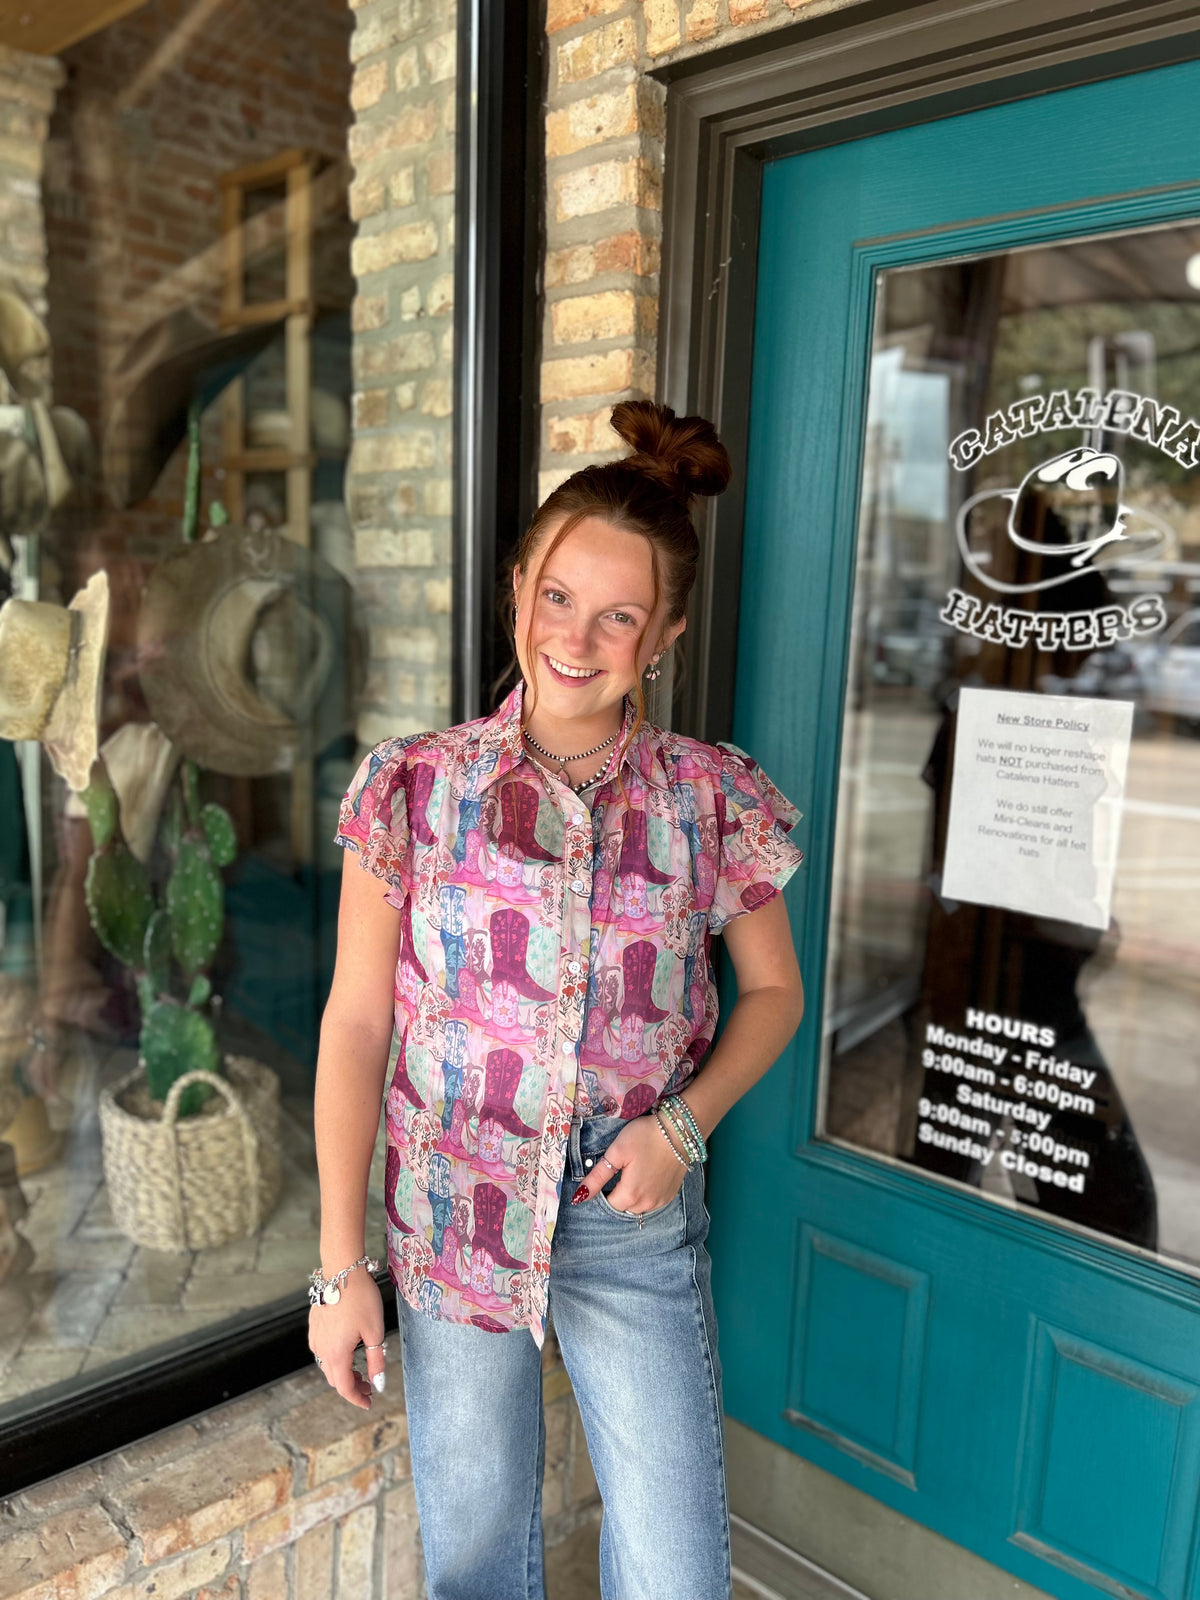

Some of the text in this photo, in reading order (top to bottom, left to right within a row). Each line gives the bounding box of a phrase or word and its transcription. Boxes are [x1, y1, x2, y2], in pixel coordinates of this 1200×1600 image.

[949, 388, 1200, 470] CATALENA
[940, 589, 1167, 650] HATTERS
[997, 713, 1089, 732] New Store Policy
[976, 753, 1105, 777] hats NOT purchased from
[978, 738, 1106, 762] We will no longer reshape
[996, 769, 1080, 789] Catalena Hatters
[994, 813, 1073, 834] Mini-Cleans and
[997, 799, 1073, 819] We do still offer
[978, 825, 1087, 851] Renovations for all felt
[1018, 846, 1040, 858] hats
[966, 1007, 1056, 1048] HOURS
[926, 1024, 1008, 1065] Monday
[1025, 1050, 1097, 1089] Friday
[922, 1049, 996, 1086] 9:00am
[1013, 1074, 1096, 1114] 6:00pm
[957, 1083, 1052, 1131] Saturday
[918, 1098, 992, 1137] 9:00am
[1009, 1129, 1090, 1168] 5:00pm
[917, 1123, 1086, 1195] Sunday Closed
